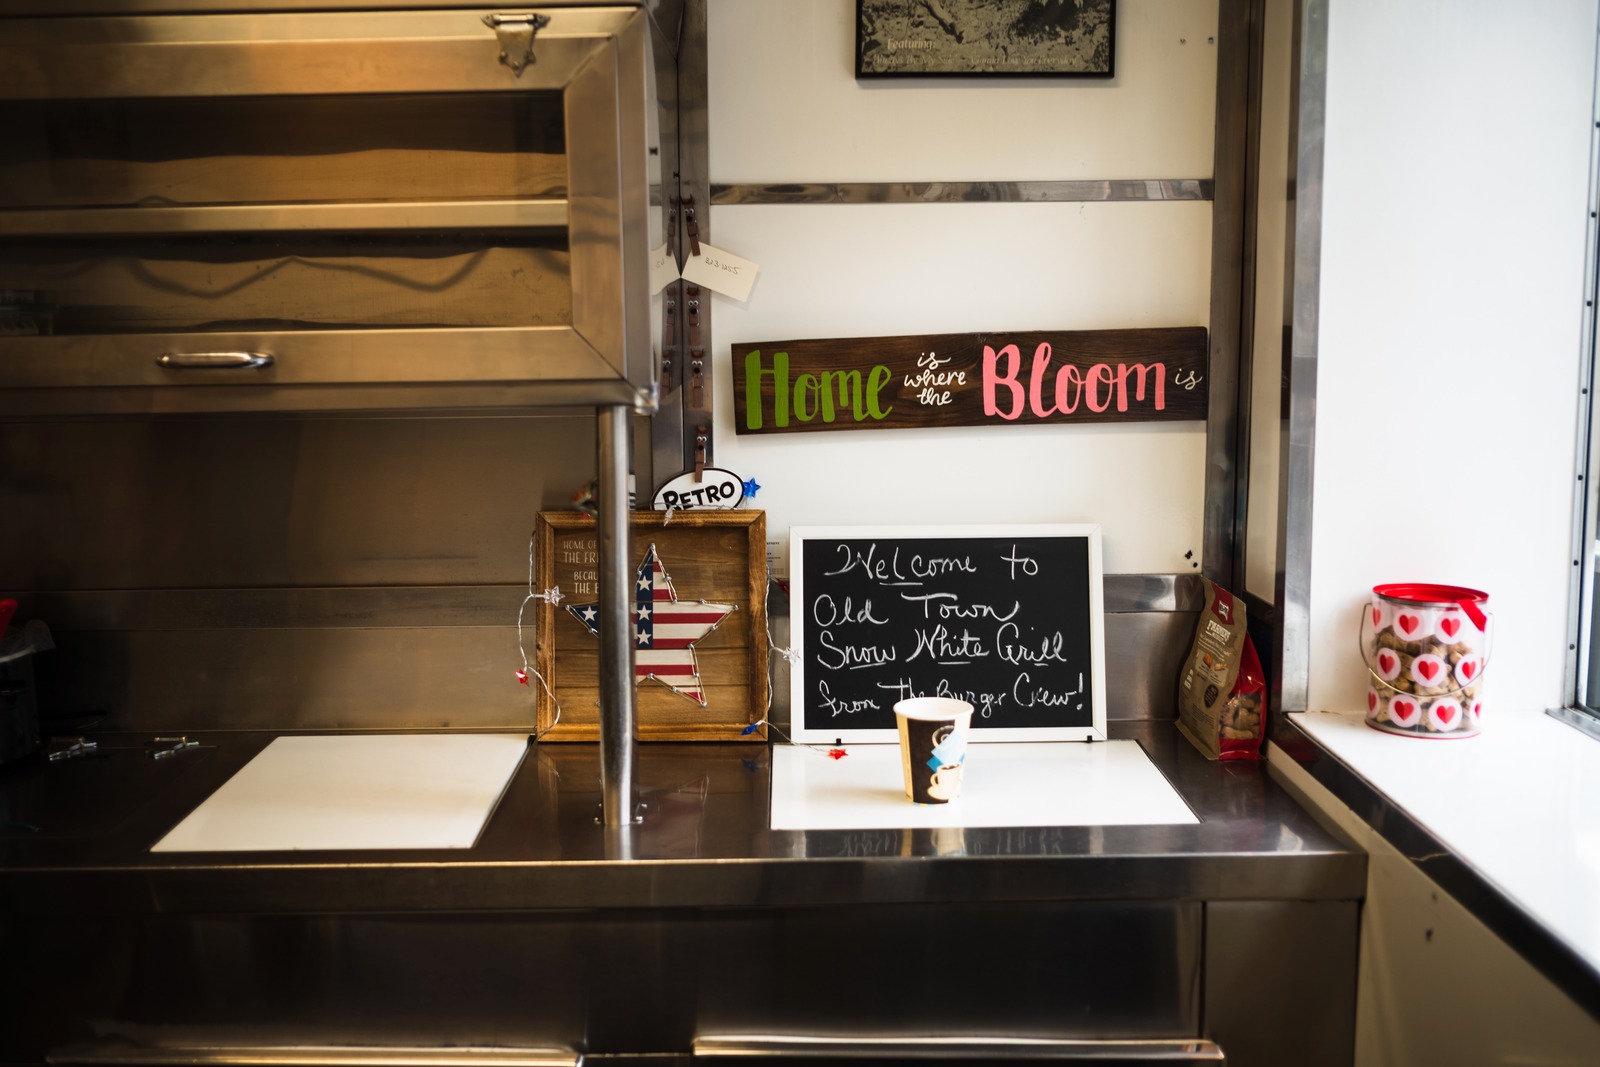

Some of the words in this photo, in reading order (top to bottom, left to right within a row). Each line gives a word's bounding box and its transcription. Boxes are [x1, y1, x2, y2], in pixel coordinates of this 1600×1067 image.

[916, 351, 951, 369] is
[744, 349, 893, 429] Home
[904, 368, 966, 390] where
[982, 342, 1166, 421] Bloom
[1175, 366, 1203, 391] is
[917, 387, 953, 406] the
[662, 481, 735, 511] RETRO
[563, 540, 584, 550] HOME
[563, 551, 581, 563] THE
[823, 543, 977, 580] Welcome
[1000, 544, 1039, 580] to
[574, 582, 591, 594] THE
[814, 594, 889, 627] Old
[900, 592, 1020, 622] Town
[817, 630, 896, 670] Snow
[905, 624, 990, 663] White
[996, 622, 1067, 665] Grill
[818, 680, 881, 717] from
[1013, 672, 1084, 711] Crew!
